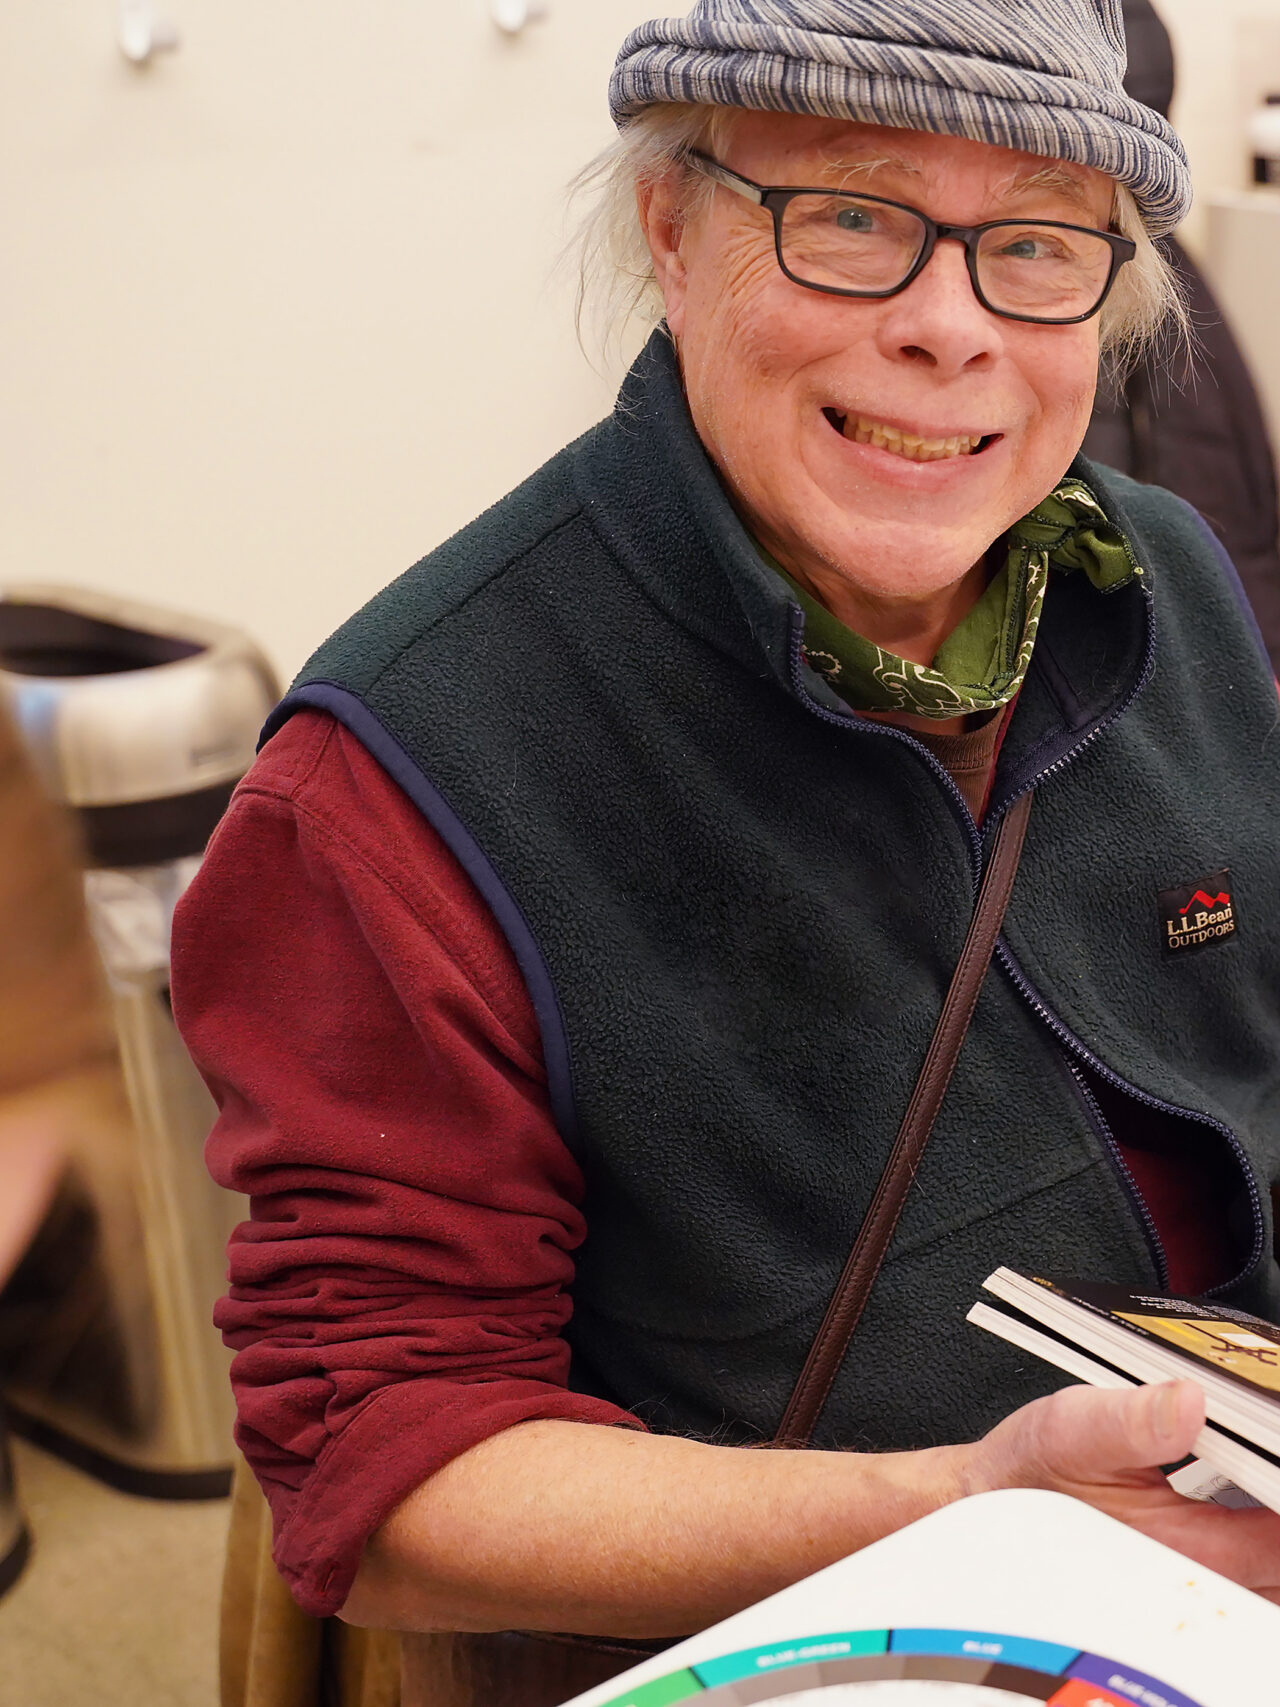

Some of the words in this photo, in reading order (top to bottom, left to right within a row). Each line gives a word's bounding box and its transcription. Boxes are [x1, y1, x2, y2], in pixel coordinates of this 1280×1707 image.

[1166, 903, 1232, 936] L.L.Bean
[1168, 919, 1235, 949] OUTDOORS
[756, 1641, 852, 1669] BLUE-GREEN
[963, 1640, 1004, 1656] BLUE
